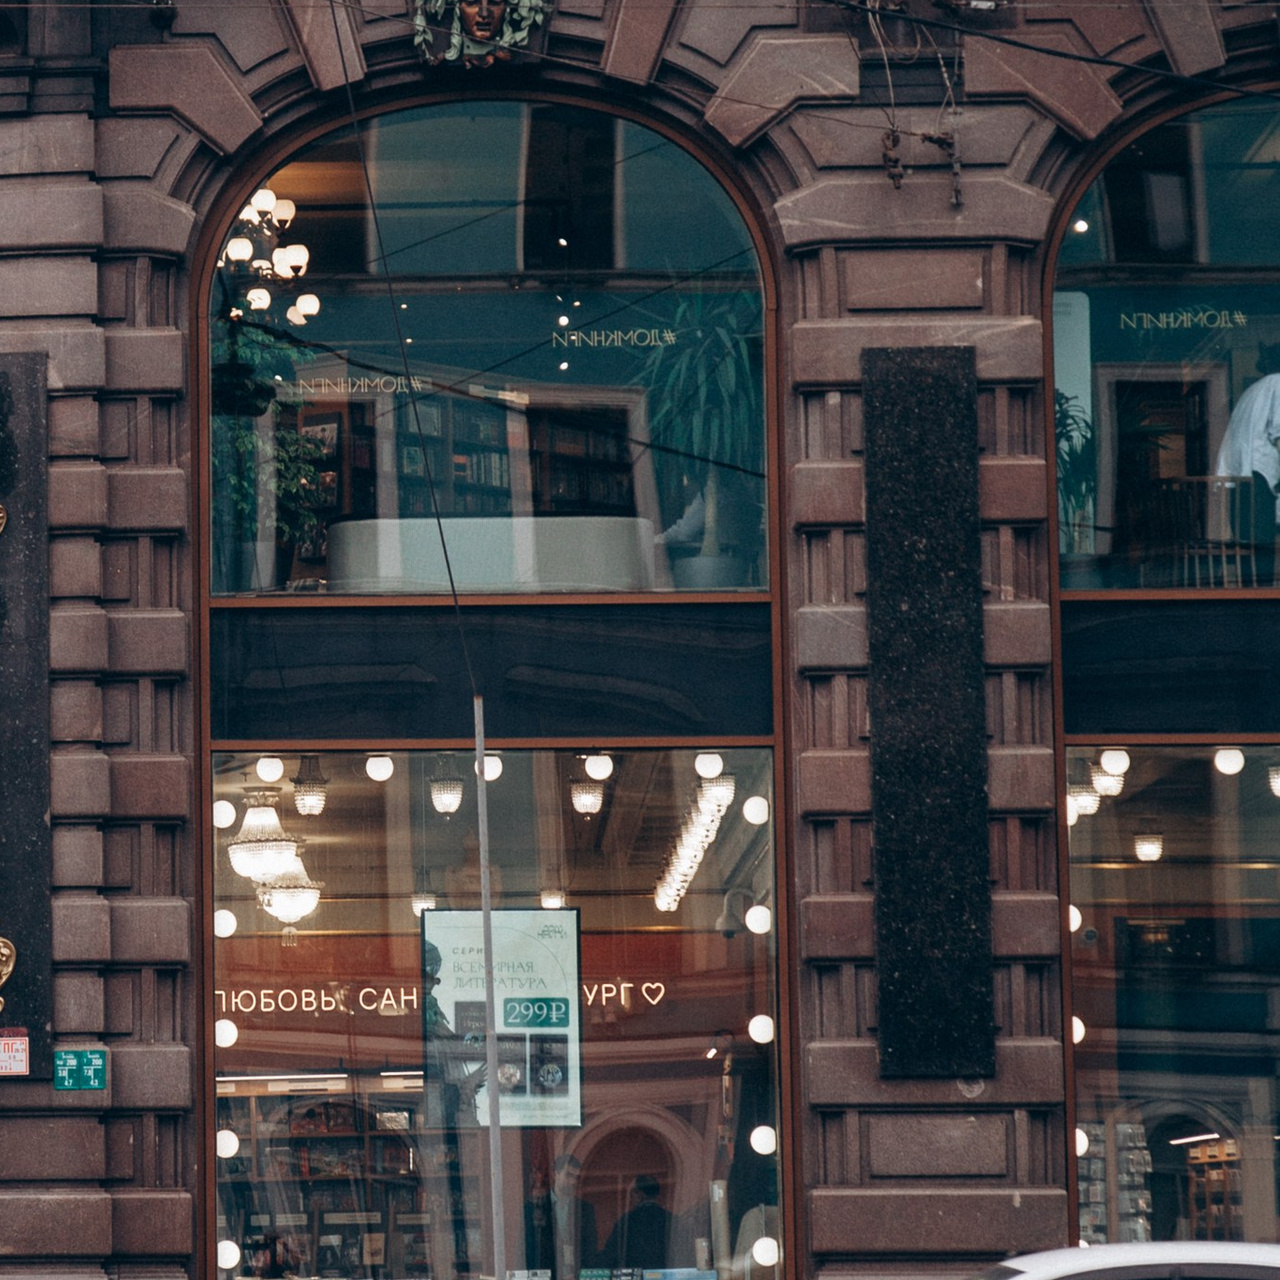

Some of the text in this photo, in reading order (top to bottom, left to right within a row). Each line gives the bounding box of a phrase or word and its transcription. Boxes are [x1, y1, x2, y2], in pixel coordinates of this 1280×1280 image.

[452, 947, 485, 955] СЕРИ
[359, 987, 418, 1010] САН
[583, 983, 634, 1006] УРГ
[506, 1002, 566, 1023] 299₽
